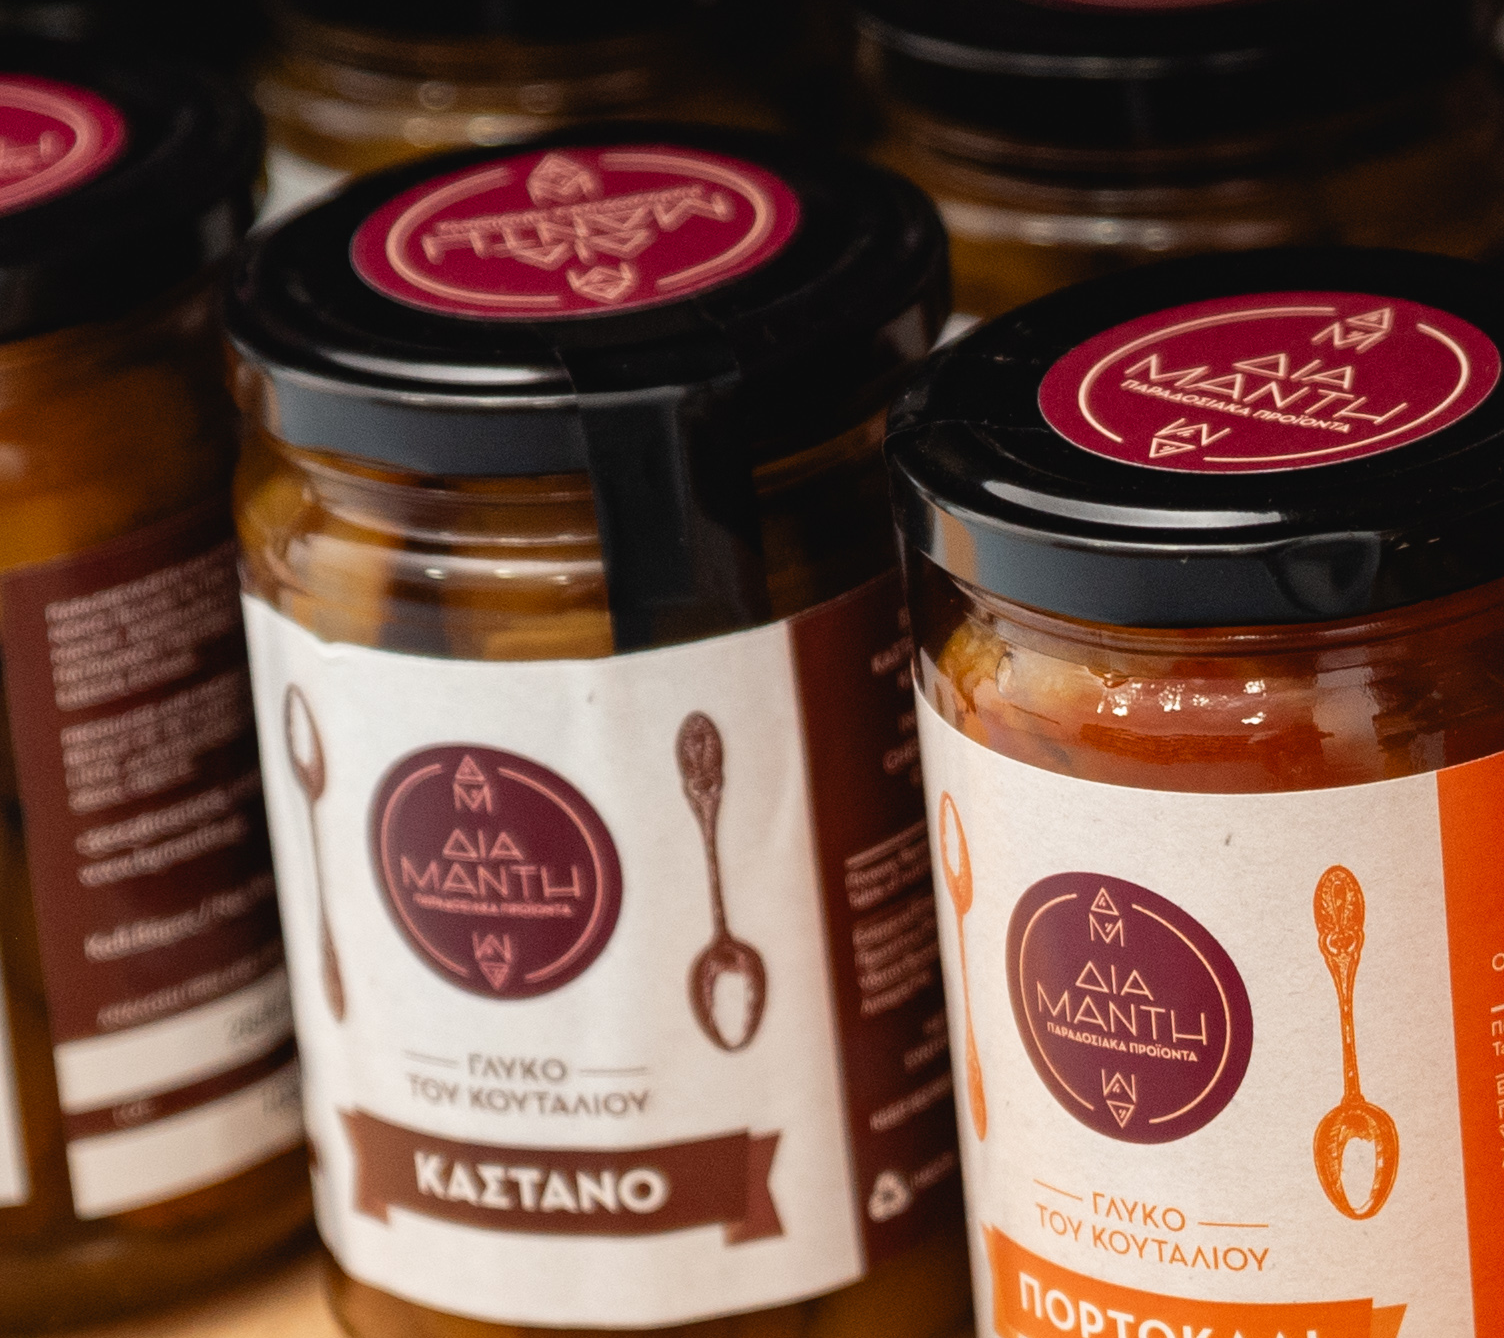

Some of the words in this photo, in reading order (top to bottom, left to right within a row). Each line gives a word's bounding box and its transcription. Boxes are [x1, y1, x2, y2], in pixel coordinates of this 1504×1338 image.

[1124, 353, 1407, 426] ΜΑΝΤΗ
[1233, 352, 1354, 390] ΔΙΑ
[443, 828, 524, 860] ΔΙΑ
[400, 855, 581, 900] ΜΑΝΤΗ
[1075, 960, 1155, 1001] ΔΙΑ
[1036, 979, 1208, 1046] ΜΑΝΤΗ
[1046, 1020, 1128, 1054] ΠΑΡΑΔΟΣΙΑΚΑ
[467, 1051, 568, 1083] ΓΛΥΚΟ
[467, 1086, 650, 1118] ΚΟΥΤΑΛΙΟΥ
[414, 1150, 670, 1214] ΚΑΣΤΑΝΟ
[1092, 1190, 1187, 1233] ΓΛΥΚΟ
[1035, 1201, 1083, 1242] ΤΟΥ
[1092, 1226, 1270, 1272] ΚΟΥΤΑΛΙΟΥ
